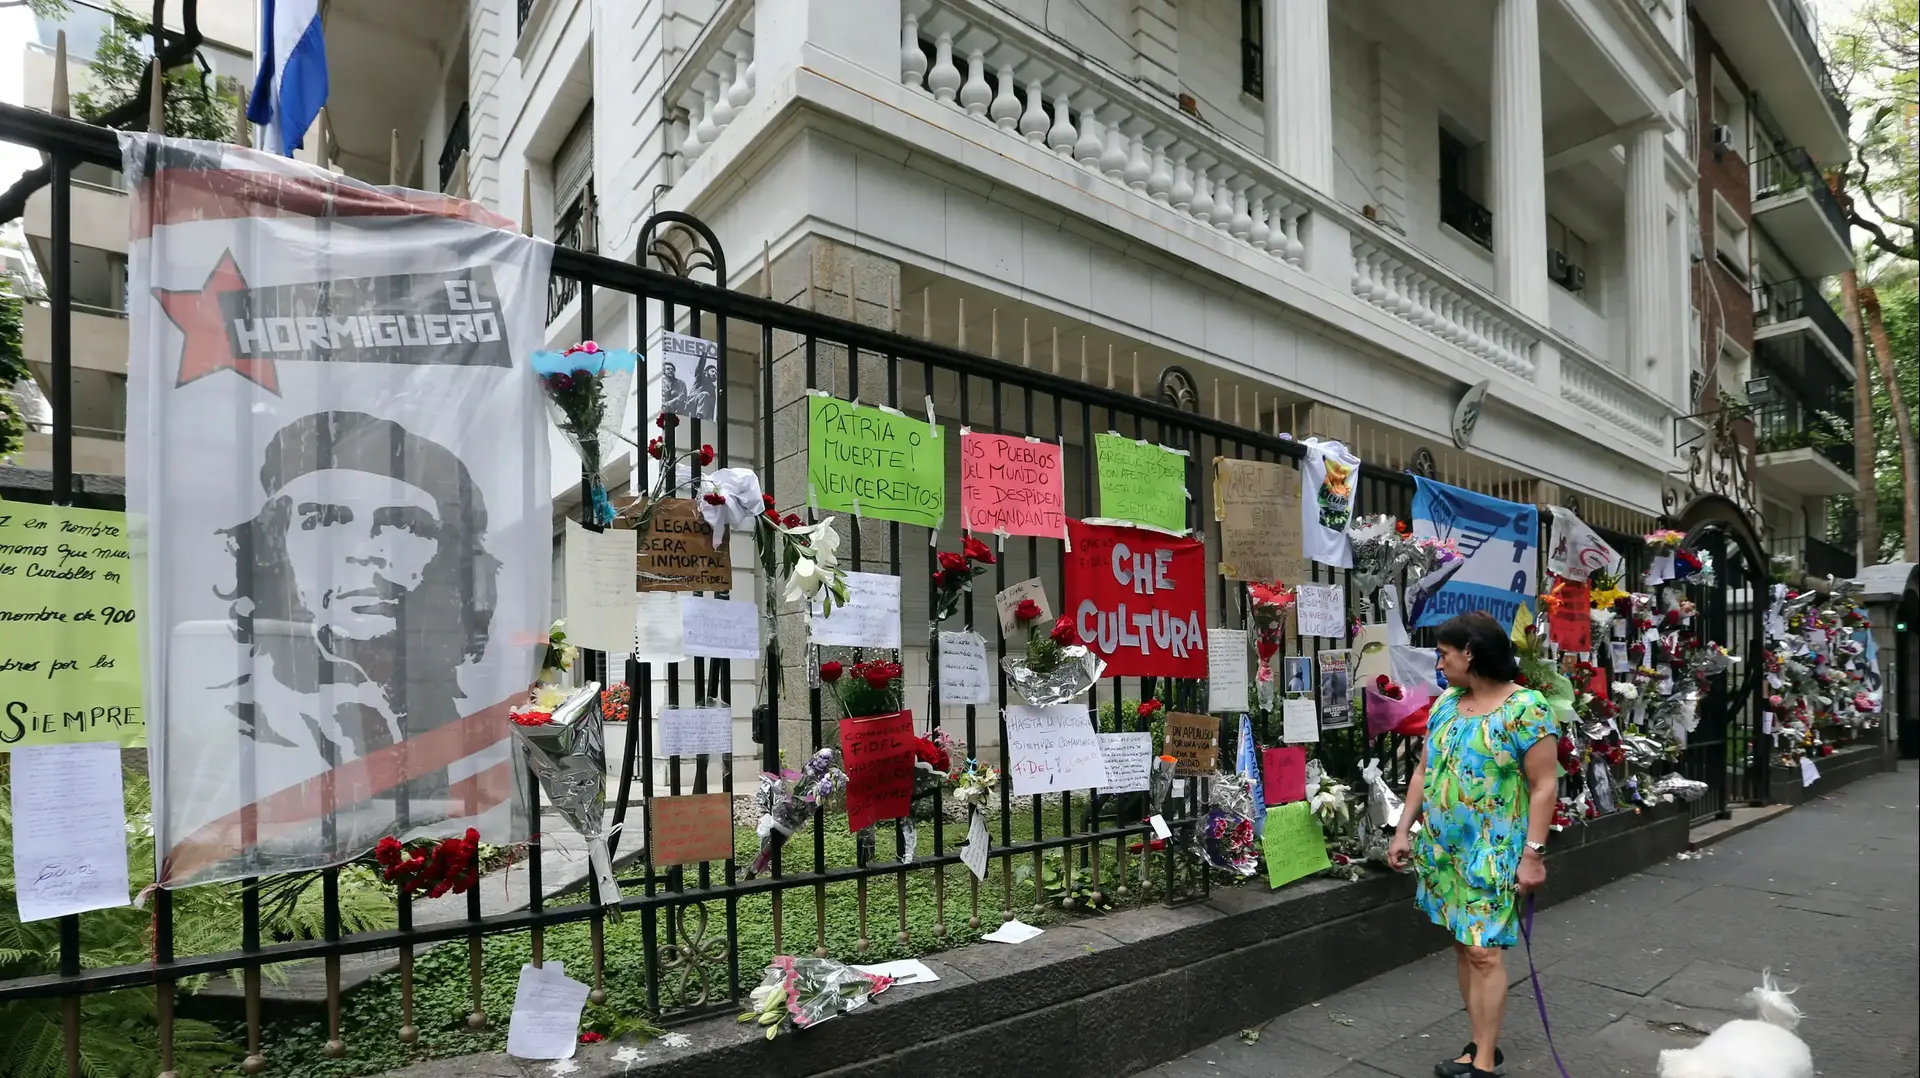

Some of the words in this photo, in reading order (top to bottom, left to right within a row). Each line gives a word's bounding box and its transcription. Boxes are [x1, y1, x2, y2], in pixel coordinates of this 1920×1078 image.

[444, 279, 492, 311] EL
[234, 312, 501, 354] HORMIGUERO
[663, 336, 717, 356] ENERO
[815, 402, 896, 442] PATRIA
[963, 435, 985, 458] LOS
[992, 439, 1056, 469] PUEBLOS
[1097, 436, 1111, 448] EL
[824, 438, 915, 471] MUERTE!
[963, 458, 984, 480] DEL
[989, 463, 1049, 485] MUNDO
[812, 464, 943, 515] VENCEREMOS!
[964, 485, 982, 500] TE
[989, 485, 1061, 507] DESPIDEN
[23, 518, 48, 530] en
[60, 520, 120, 537] nombre
[654, 518, 712, 535] LEGADO
[970, 506, 1062, 529] COMANDANTE
[651, 555, 725, 568] INMORTAL
[1080, 557, 1108, 570] FIDEL
[1112, 542, 1177, 595] CHE
[0, 606, 68, 623] nombre
[73, 609, 97, 622] de
[101, 606, 137, 626] 900
[1077, 598, 1204, 659] CULTURA
[48, 659, 80, 679] por
[89, 654, 116, 669] los
[844, 722, 912, 741] COMANDANTE
[1172, 725, 1182, 736] UN
[1183, 727, 1214, 740] APLAUSO
[851, 738, 903, 756] FIDEL
[1012, 737, 1055, 751] SIEMPRE
